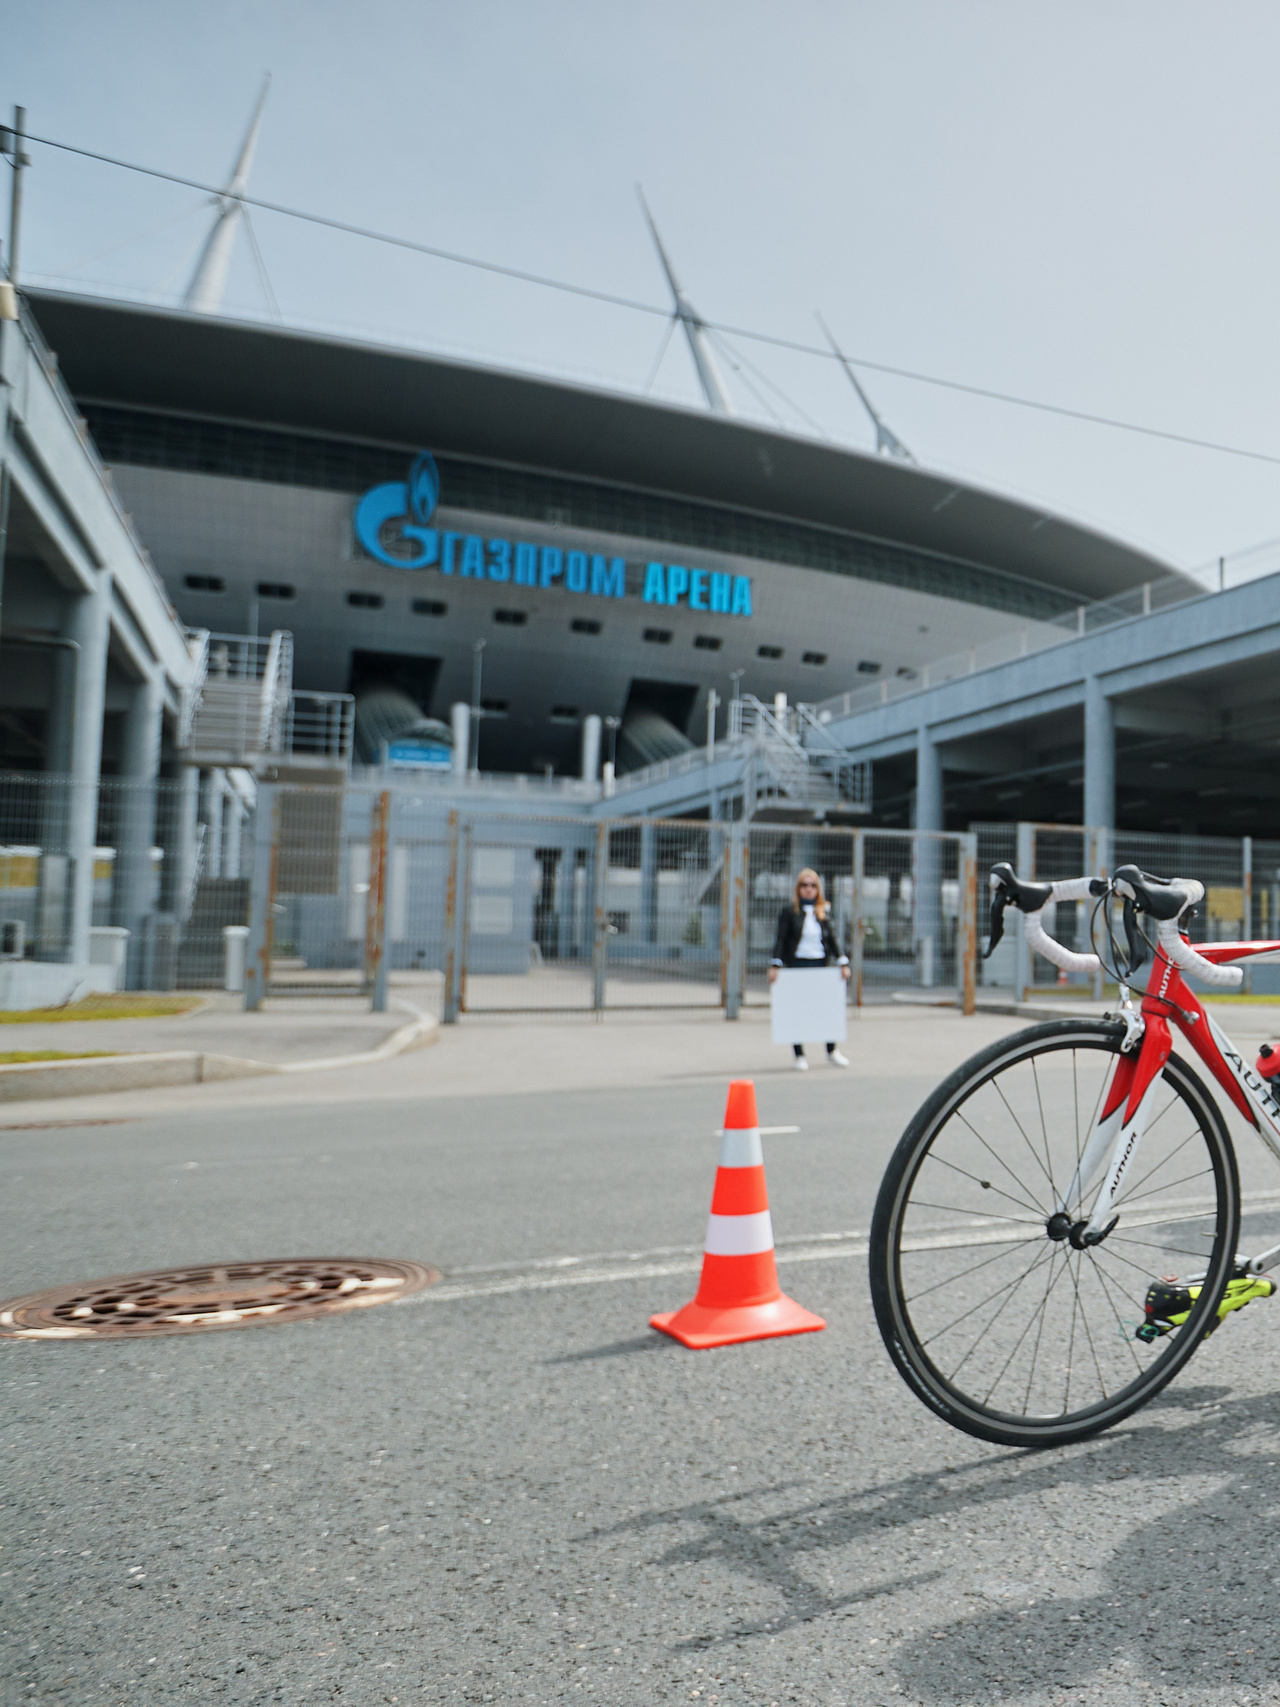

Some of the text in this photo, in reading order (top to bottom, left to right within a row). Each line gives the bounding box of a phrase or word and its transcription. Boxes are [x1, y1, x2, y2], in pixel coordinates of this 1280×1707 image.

[440, 528, 754, 617] ГАЗПРОМ АРЕНА
[1110, 1131, 1137, 1199] AUTHOR
